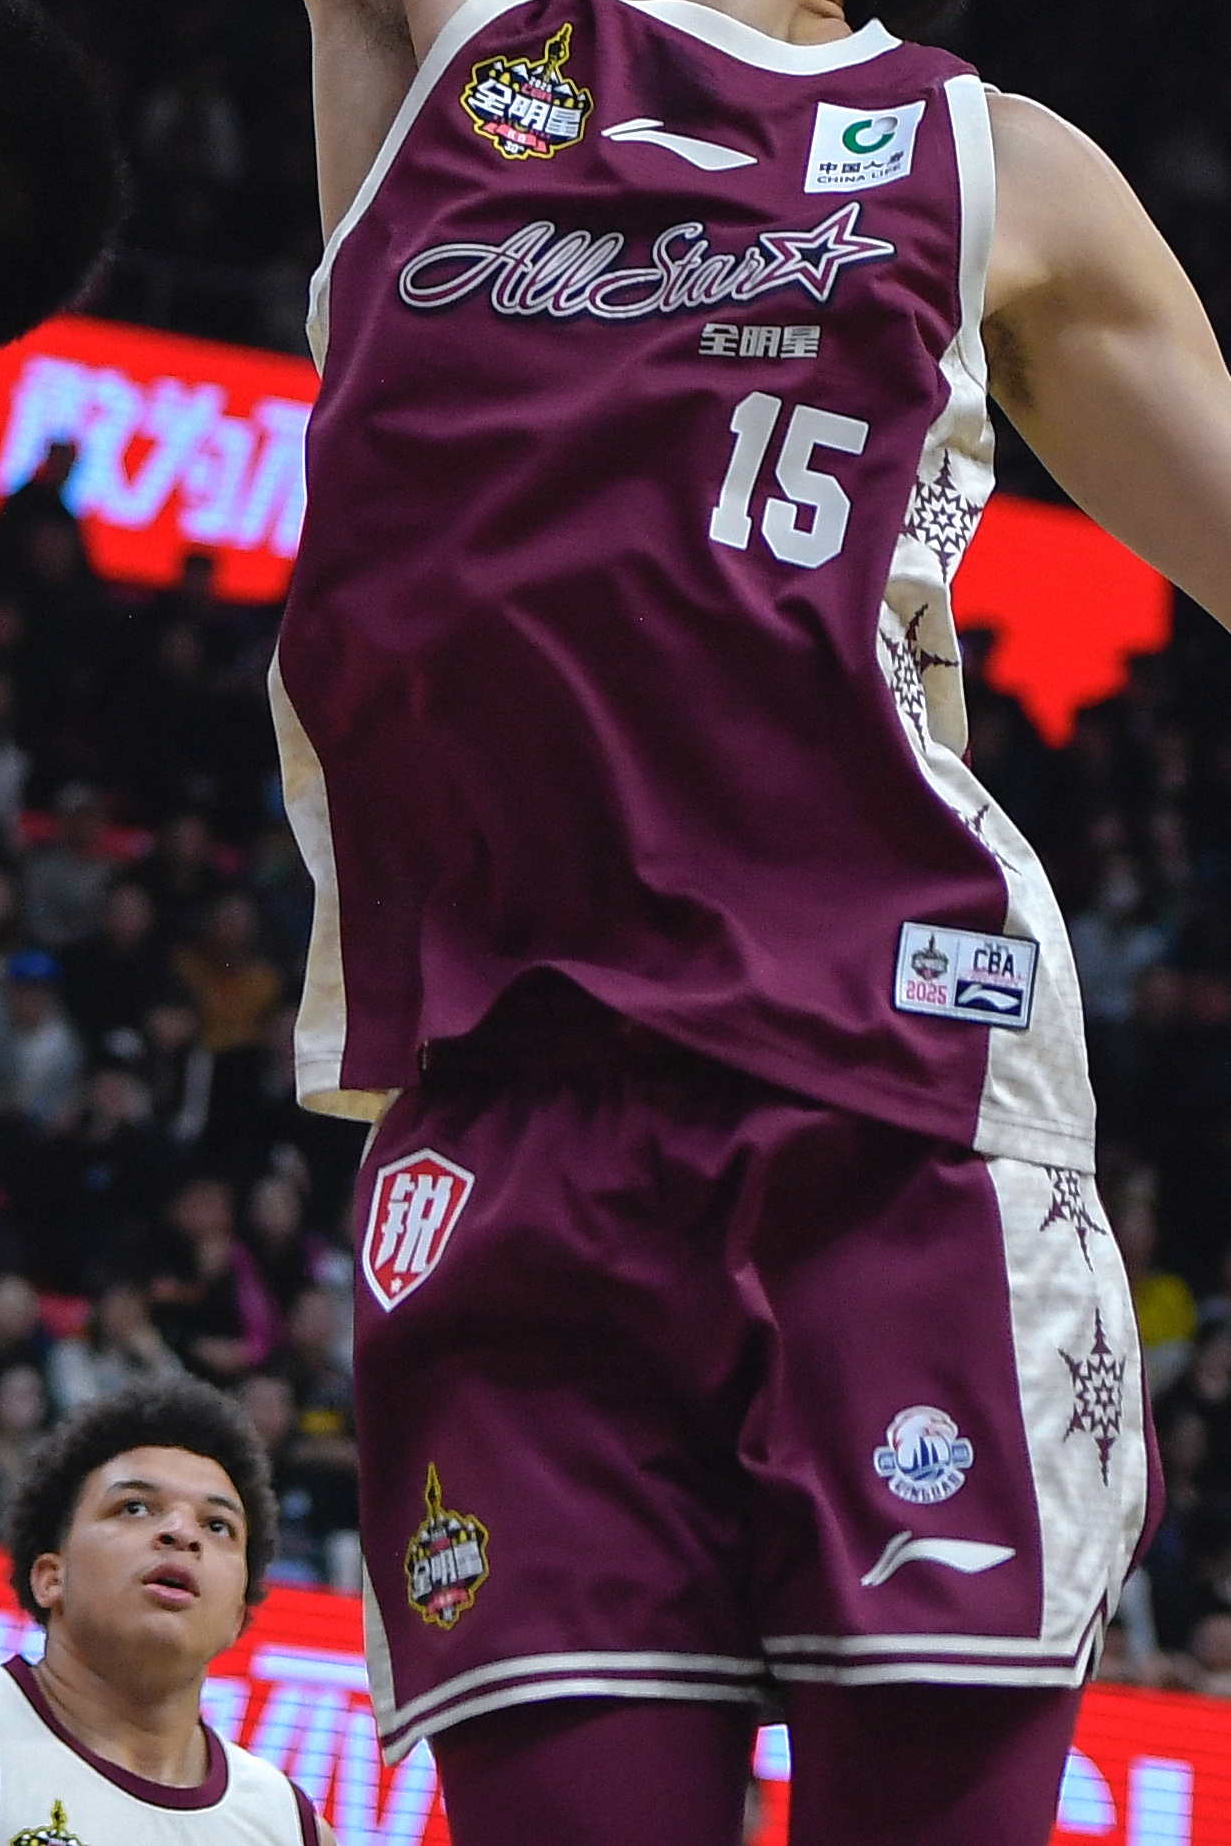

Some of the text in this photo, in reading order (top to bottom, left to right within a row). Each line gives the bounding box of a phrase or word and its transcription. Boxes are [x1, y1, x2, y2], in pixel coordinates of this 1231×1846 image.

[468, 78, 583, 138] 全明星
[817, 174, 866, 184] CHINA
[399, 221, 771, 318] All Star
[699, 322, 822, 358] 全明星
[709, 391, 869, 569] 15
[973, 948, 1016, 979] CBA
[905, 980, 948, 1006] 2025
